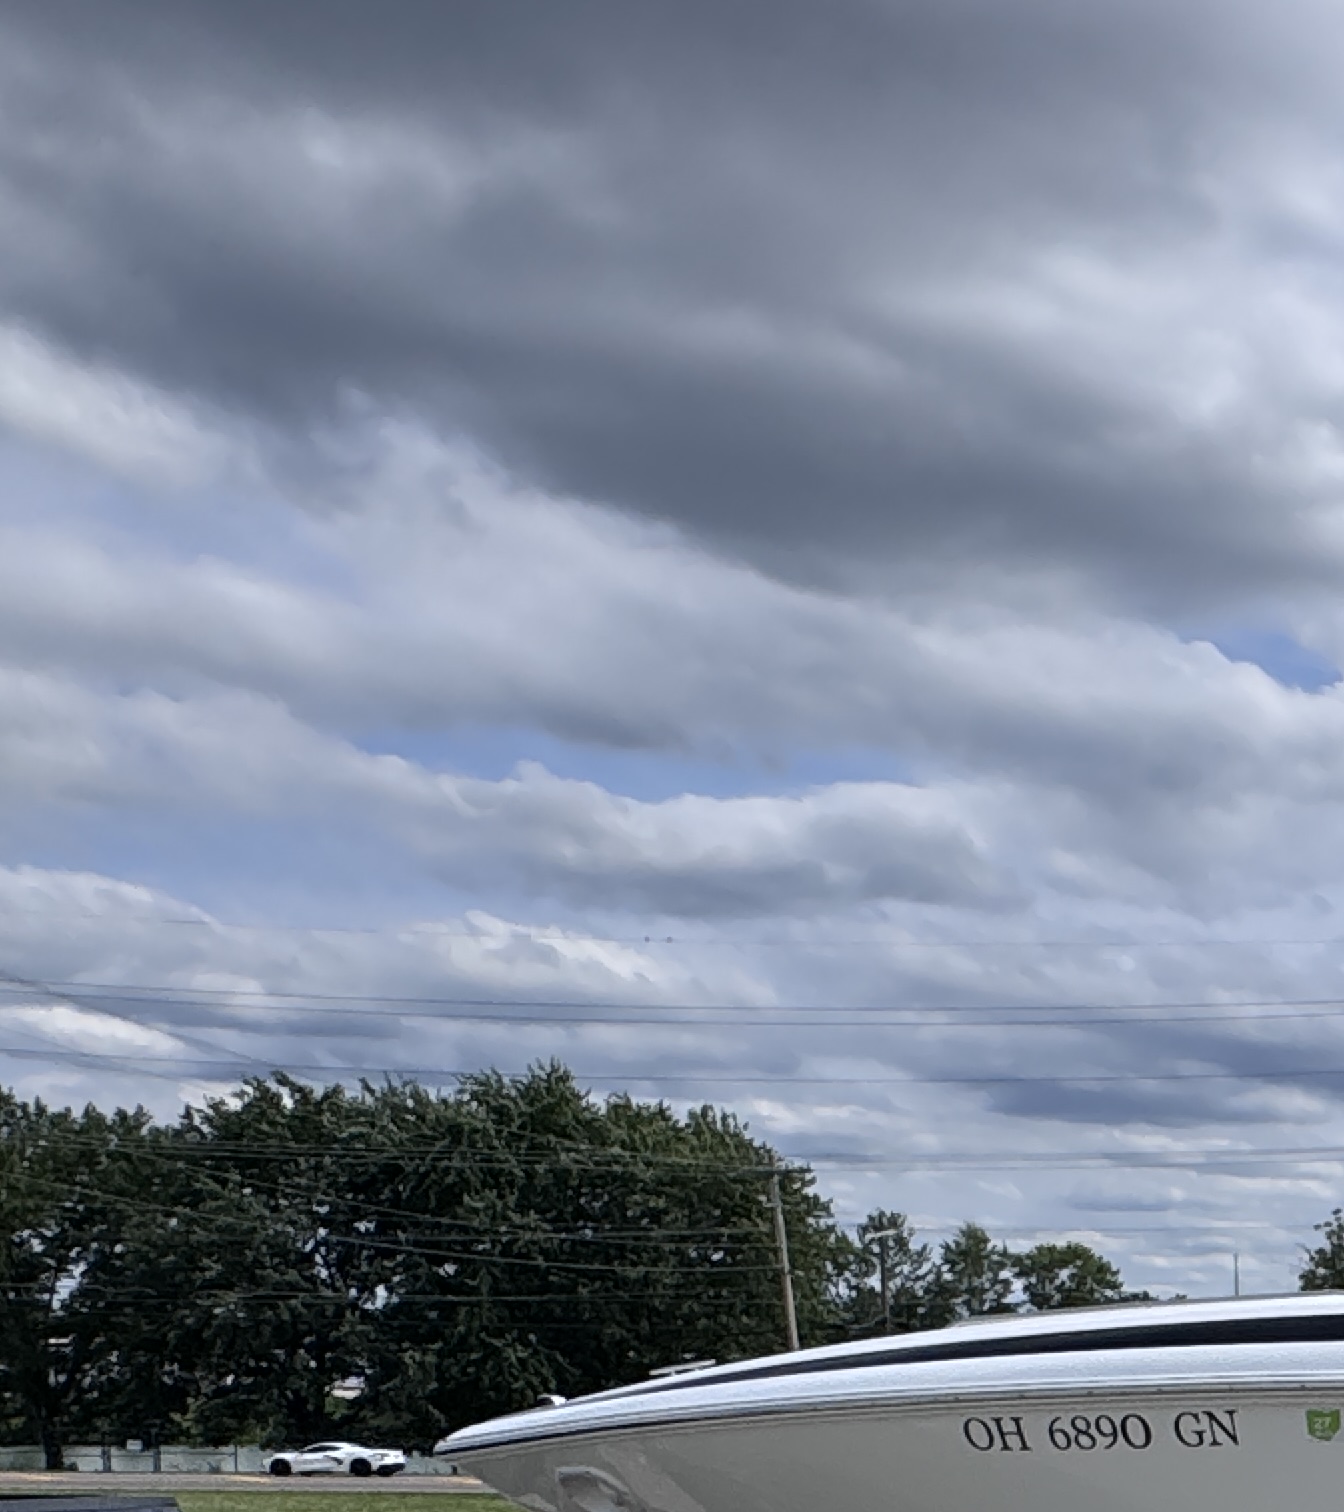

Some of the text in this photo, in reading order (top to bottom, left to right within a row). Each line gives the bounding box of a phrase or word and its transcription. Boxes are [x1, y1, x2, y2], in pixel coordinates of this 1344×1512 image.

[963, 1409, 1240, 1452] OH 6890 GN
